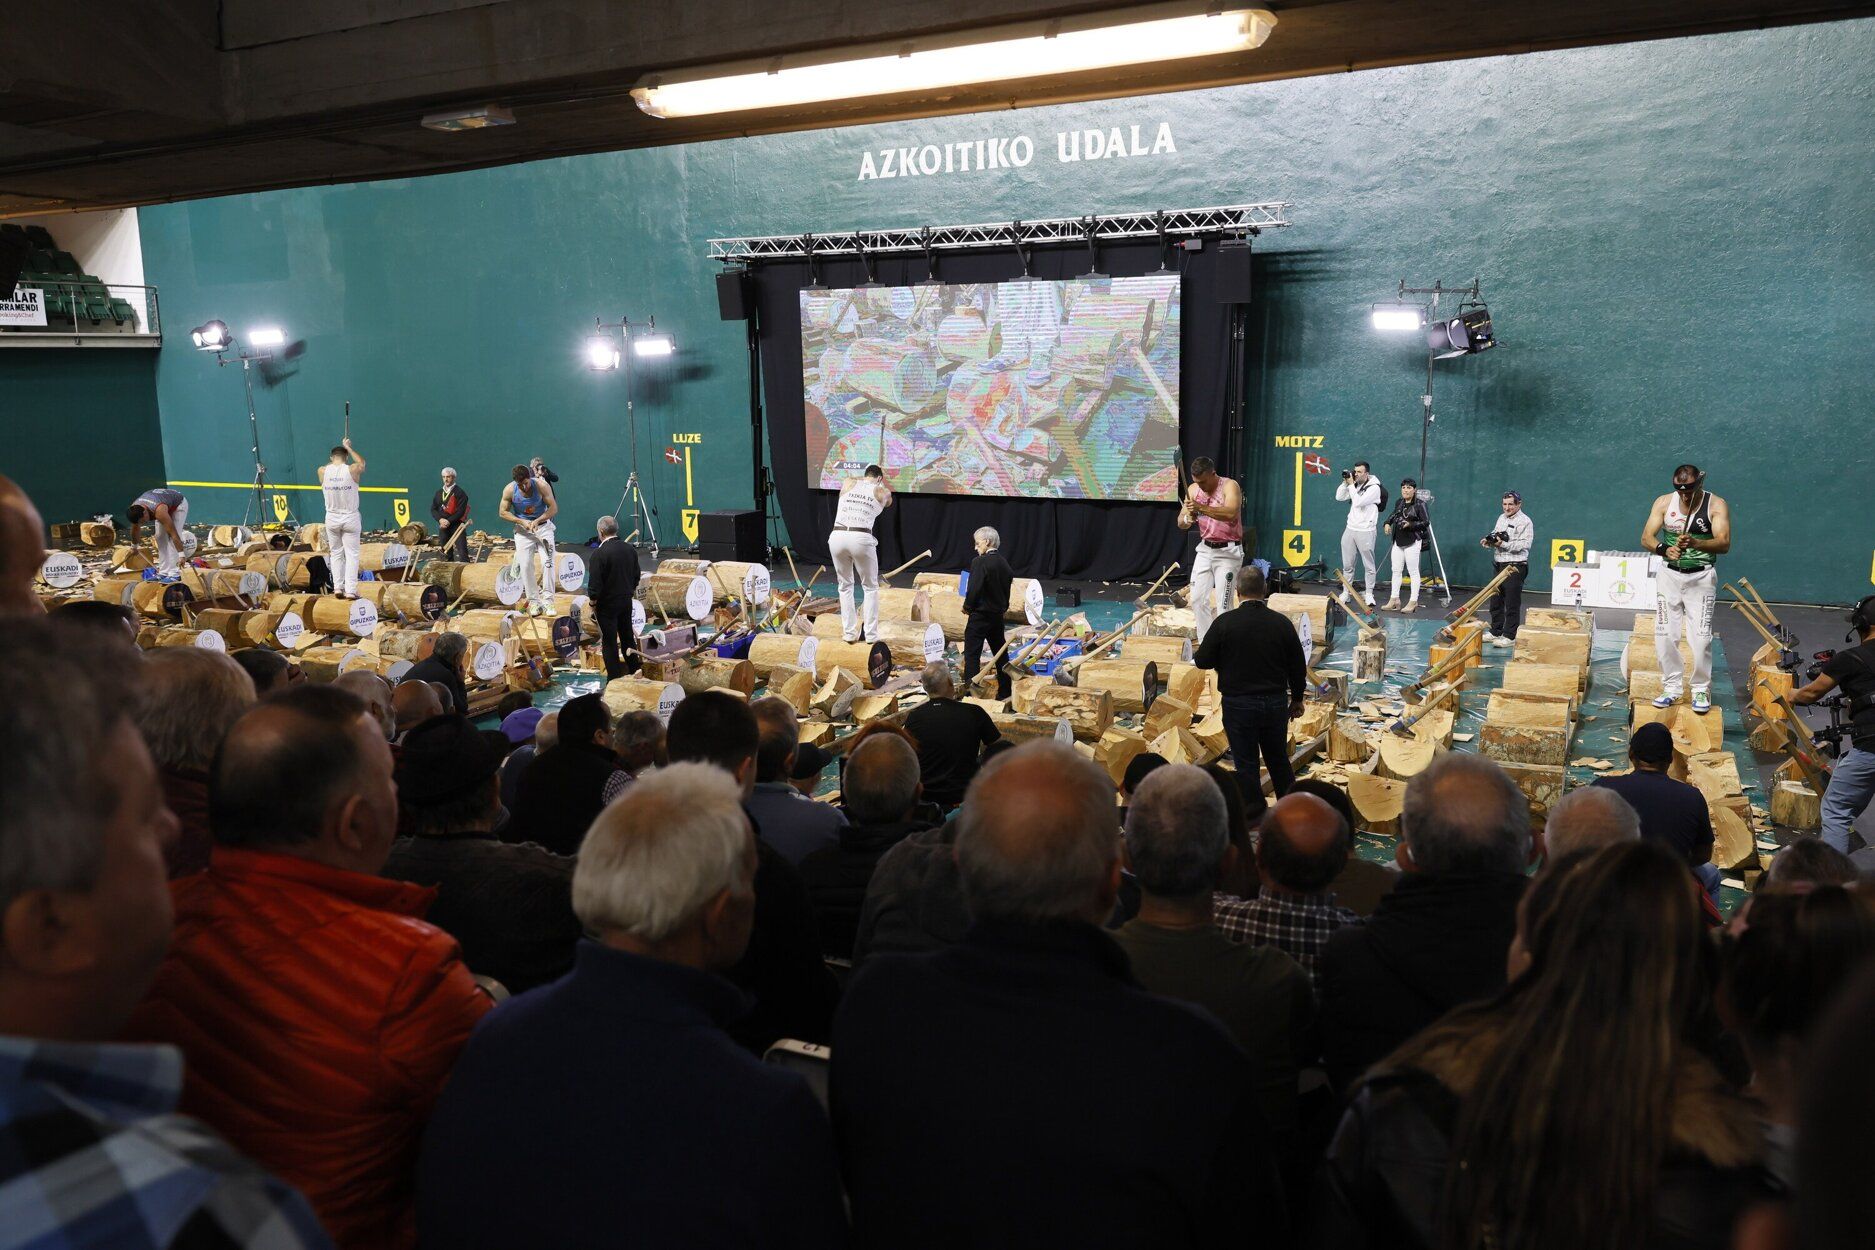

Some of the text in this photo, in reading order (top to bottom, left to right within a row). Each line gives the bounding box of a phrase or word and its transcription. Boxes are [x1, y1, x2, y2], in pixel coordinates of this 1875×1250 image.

[857, 122, 1178, 181] AZKOITIKO UDALA
[672, 433, 702, 444] LUZE
[1275, 435, 1325, 448] MOTZ
[274, 498, 286, 511] 10
[397, 502, 407, 516] 9
[686, 513, 696, 528] 7
[1288, 534, 1306, 554] 4
[1558, 544, 1577, 562] 3
[45, 565, 79, 573] EUSKADI
[1618, 560, 1628, 577] 1
[560, 571, 584, 580] GIPUZKOA
[1570, 572, 1582, 588] 2
[350, 616, 377, 626] GIPUZKOA
[277, 624, 302, 634] EUSKADI
